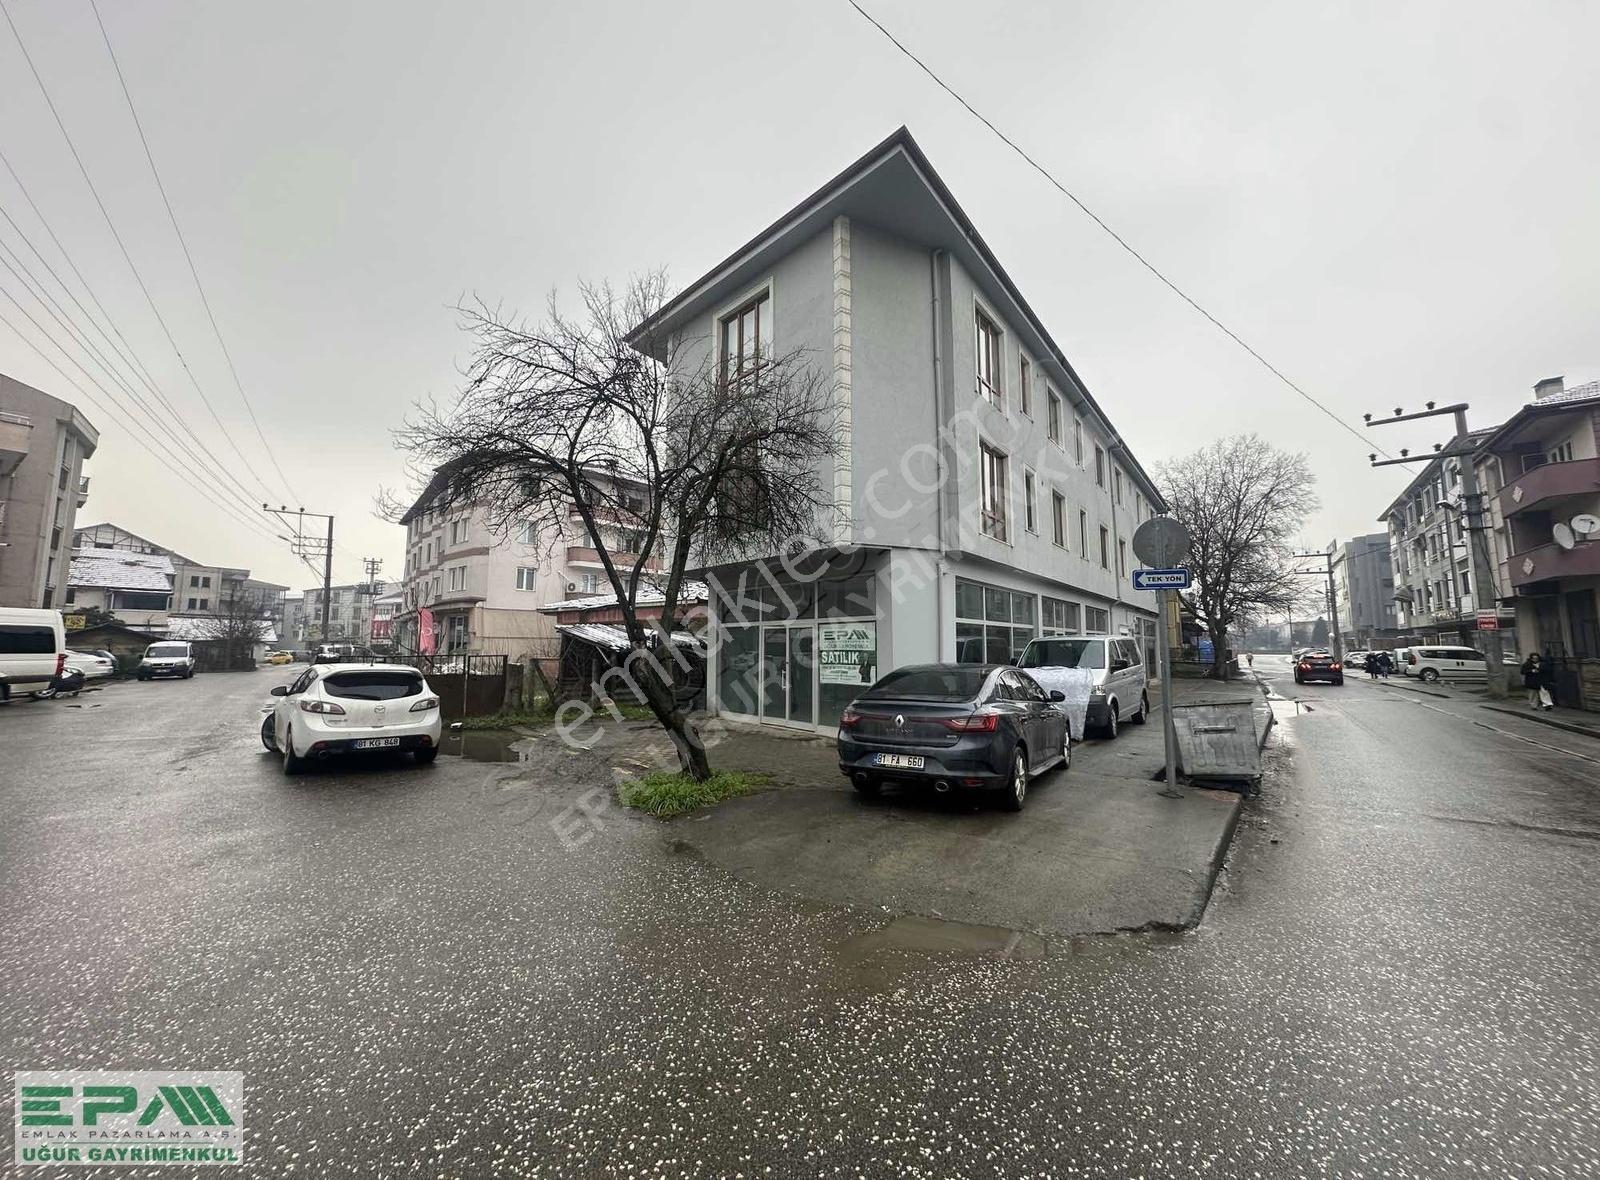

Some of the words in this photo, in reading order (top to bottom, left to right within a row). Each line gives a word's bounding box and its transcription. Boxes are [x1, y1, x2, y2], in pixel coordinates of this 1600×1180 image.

[821, 651, 860, 664] SATILIK
[877, 753, 886, 763] 81
[891, 754, 900, 764] FA
[907, 756, 923, 767] 660
